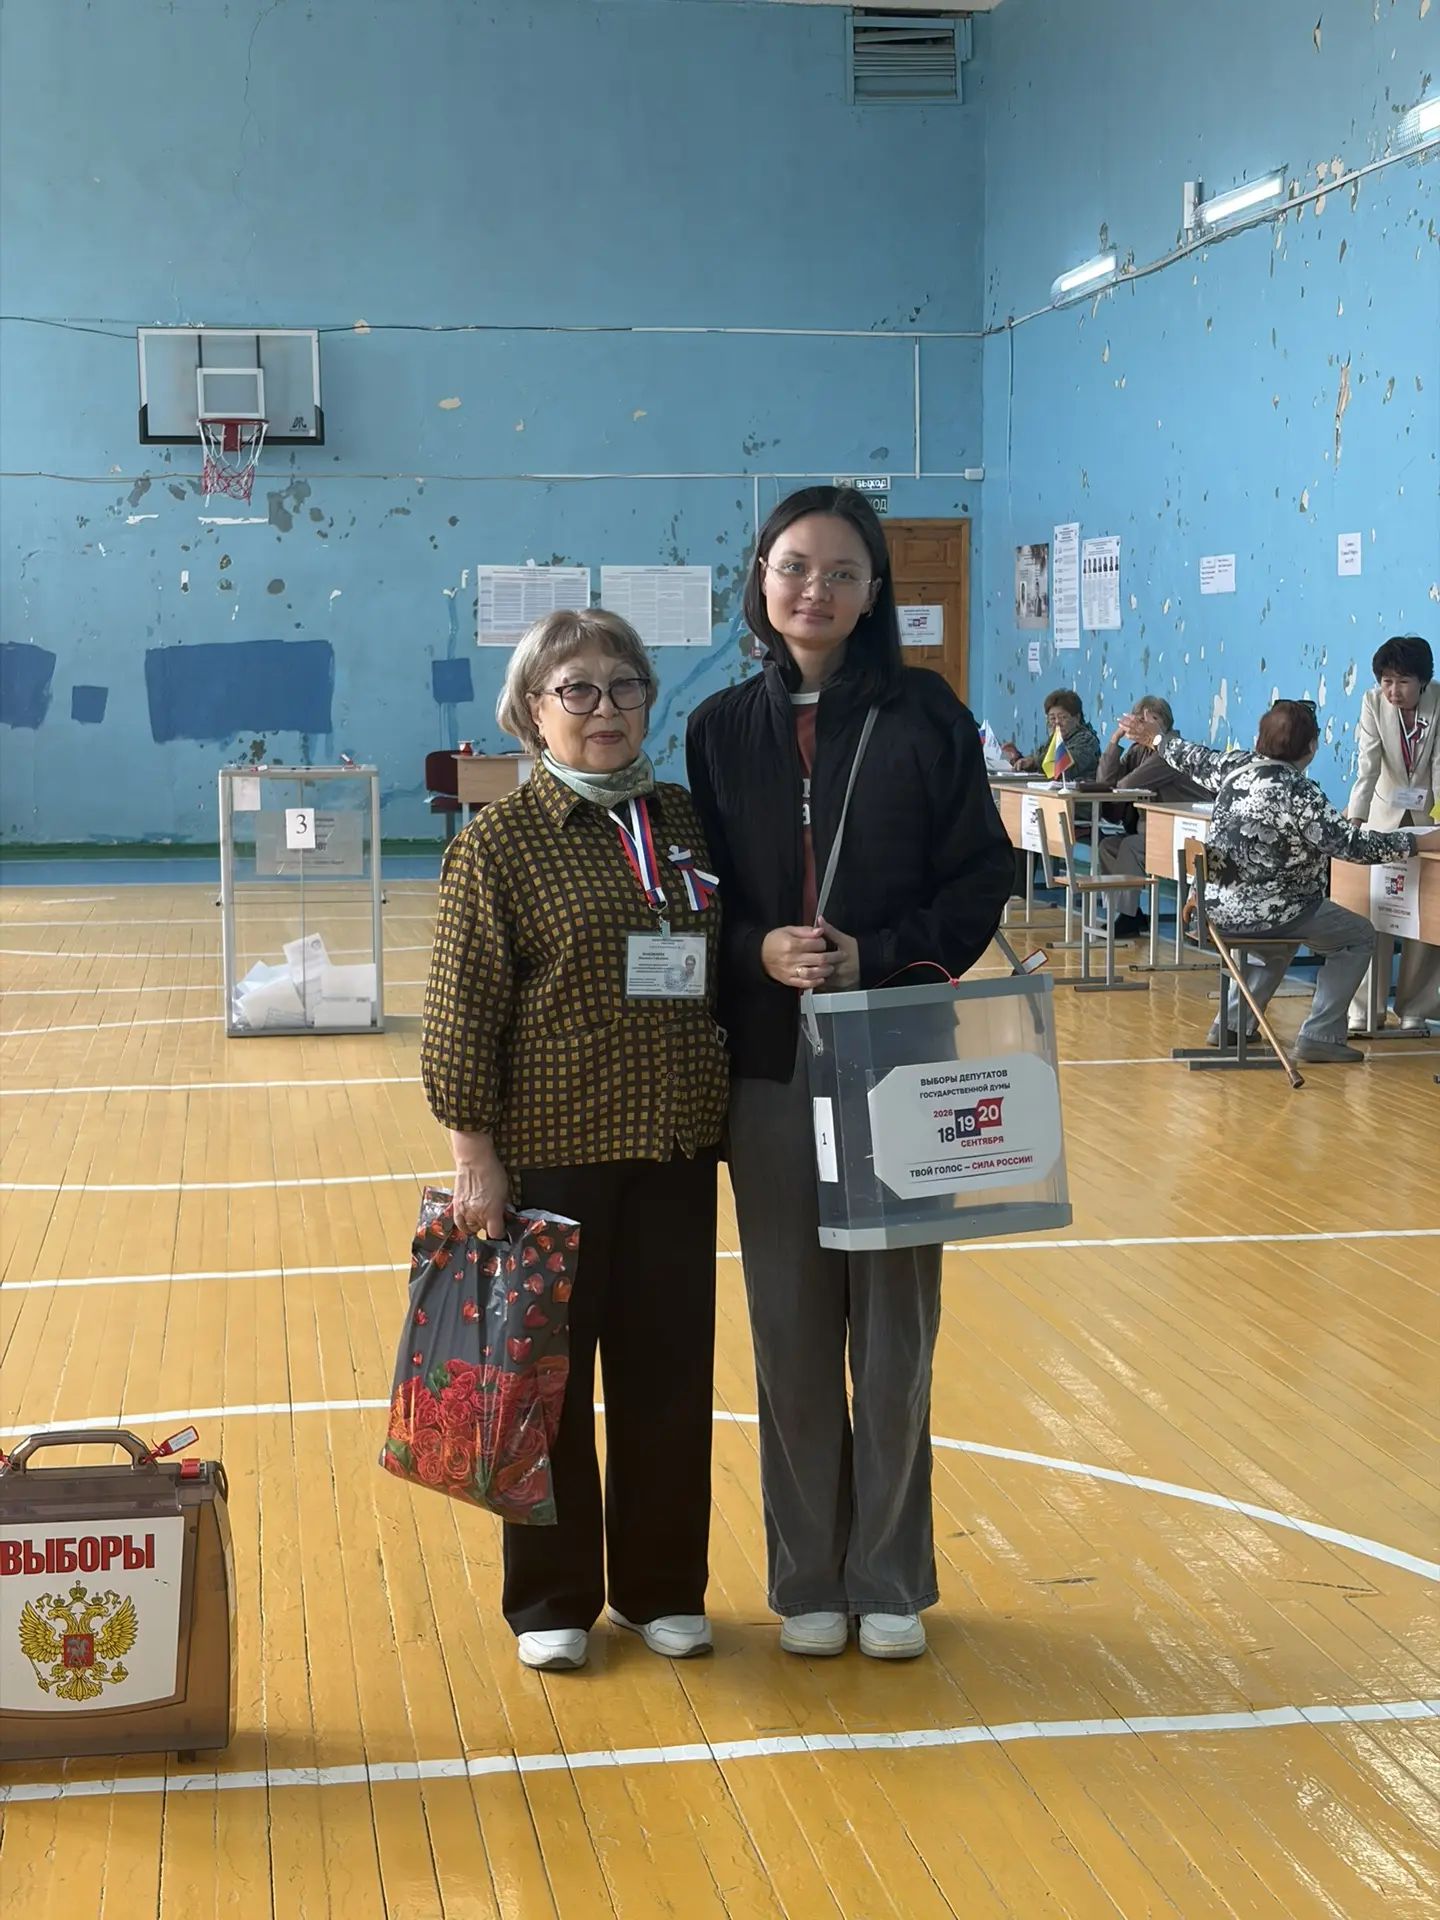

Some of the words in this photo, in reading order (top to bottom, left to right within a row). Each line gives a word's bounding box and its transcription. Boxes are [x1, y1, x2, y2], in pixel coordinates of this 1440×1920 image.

[295, 813, 308, 835] 3
[920, 1075, 958, 1087] ВЫБОРЫ
[959, 1069, 1008, 1083] ДЕПУТАТОВ
[919, 1083, 988, 1099] ГОСУДАРСТВЕННОЙ
[989, 1082, 1011, 1092] ДУМЫ
[933, 1109, 953, 1118] 2026
[938, 1126, 955, 1143] 18
[957, 1115, 976, 1132] 19
[977, 1104, 999, 1122] 20
[822, 1132, 828, 1145] 1
[960, 1135, 1004, 1148] СЕНТЯБРЯ
[910, 1166, 933, 1178] ТВОЙ
[934, 1164, 963, 1175] ГОЛОС
[971, 1160, 995, 1170] СИЛА
[996, 1155, 1033, 1167] РОССИИ!
[0, 1533, 155, 1576] ВЫБОРЫ
